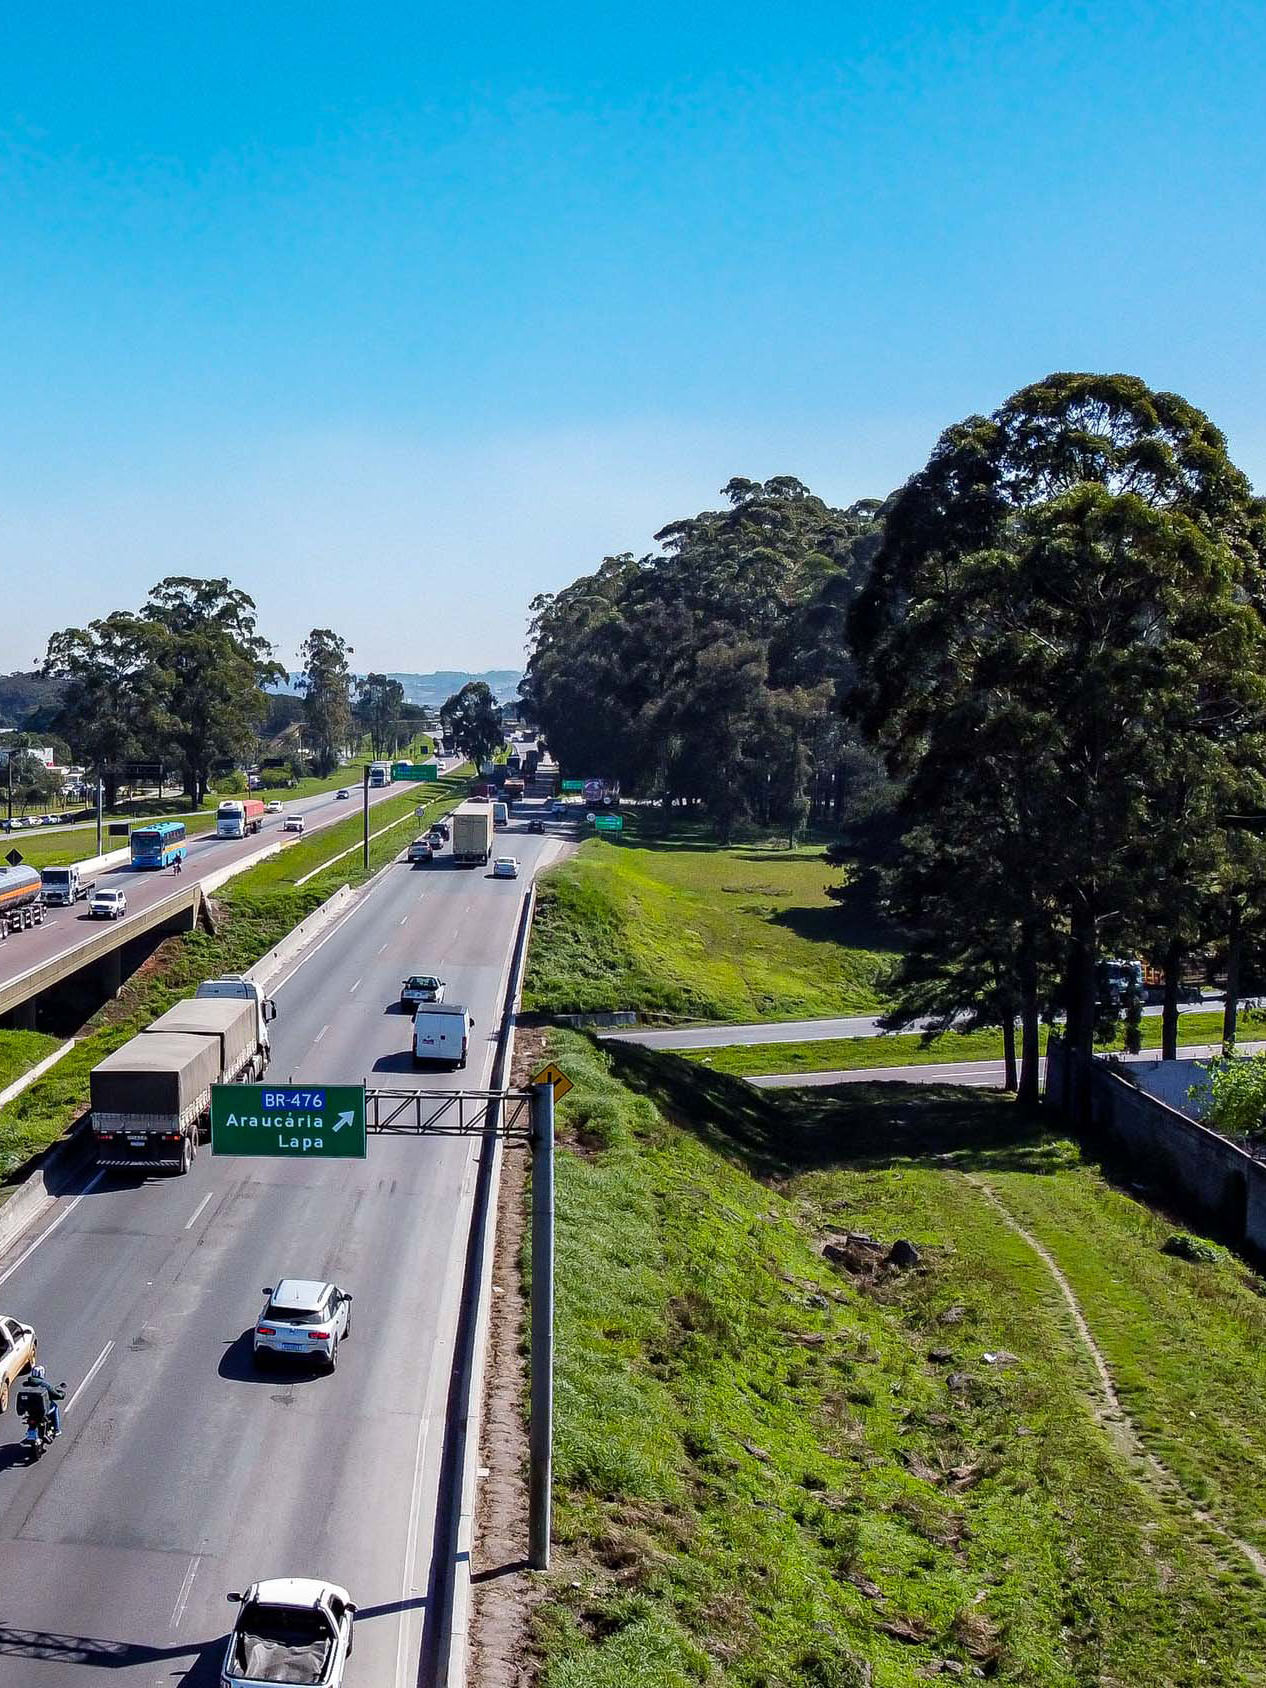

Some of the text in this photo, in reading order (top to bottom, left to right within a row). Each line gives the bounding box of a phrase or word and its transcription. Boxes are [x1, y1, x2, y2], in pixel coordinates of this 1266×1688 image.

[265, 1093, 323, 1108] BR-476
[226, 1111, 323, 1128] Araucária
[278, 1134, 324, 1152] Lapa
